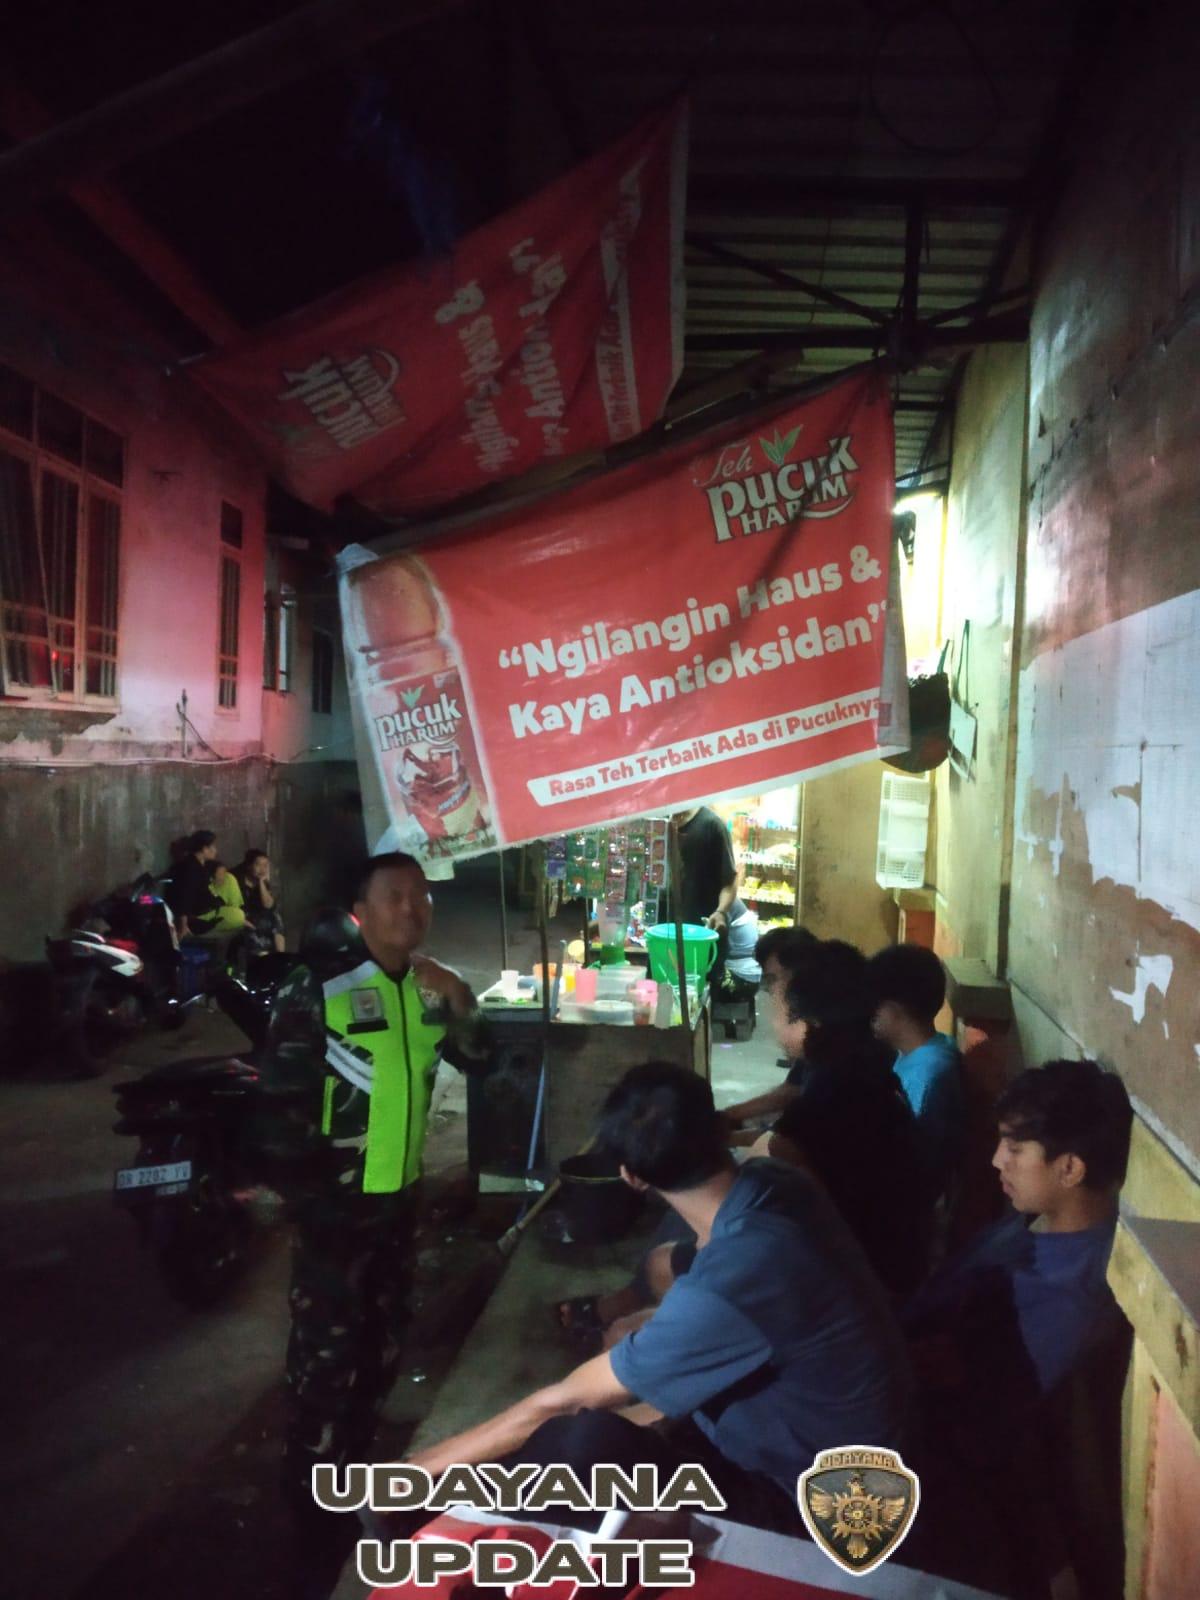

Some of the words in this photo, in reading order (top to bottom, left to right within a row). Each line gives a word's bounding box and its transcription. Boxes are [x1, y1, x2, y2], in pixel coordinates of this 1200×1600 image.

[692, 439, 753, 488] Teh
[498, 597, 731, 679] “Ngilangin
[737, 561, 842, 618] Haus
[849, 545, 882, 584] &
[392, 721, 456, 749] HARUM
[508, 692, 611, 739] Kaya
[548, 774, 596, 797] Rasa
[597, 761, 634, 785] Teh
[636, 740, 714, 775] Terbaik
[716, 729, 759, 754] Ada
[762, 719, 784, 741] di
